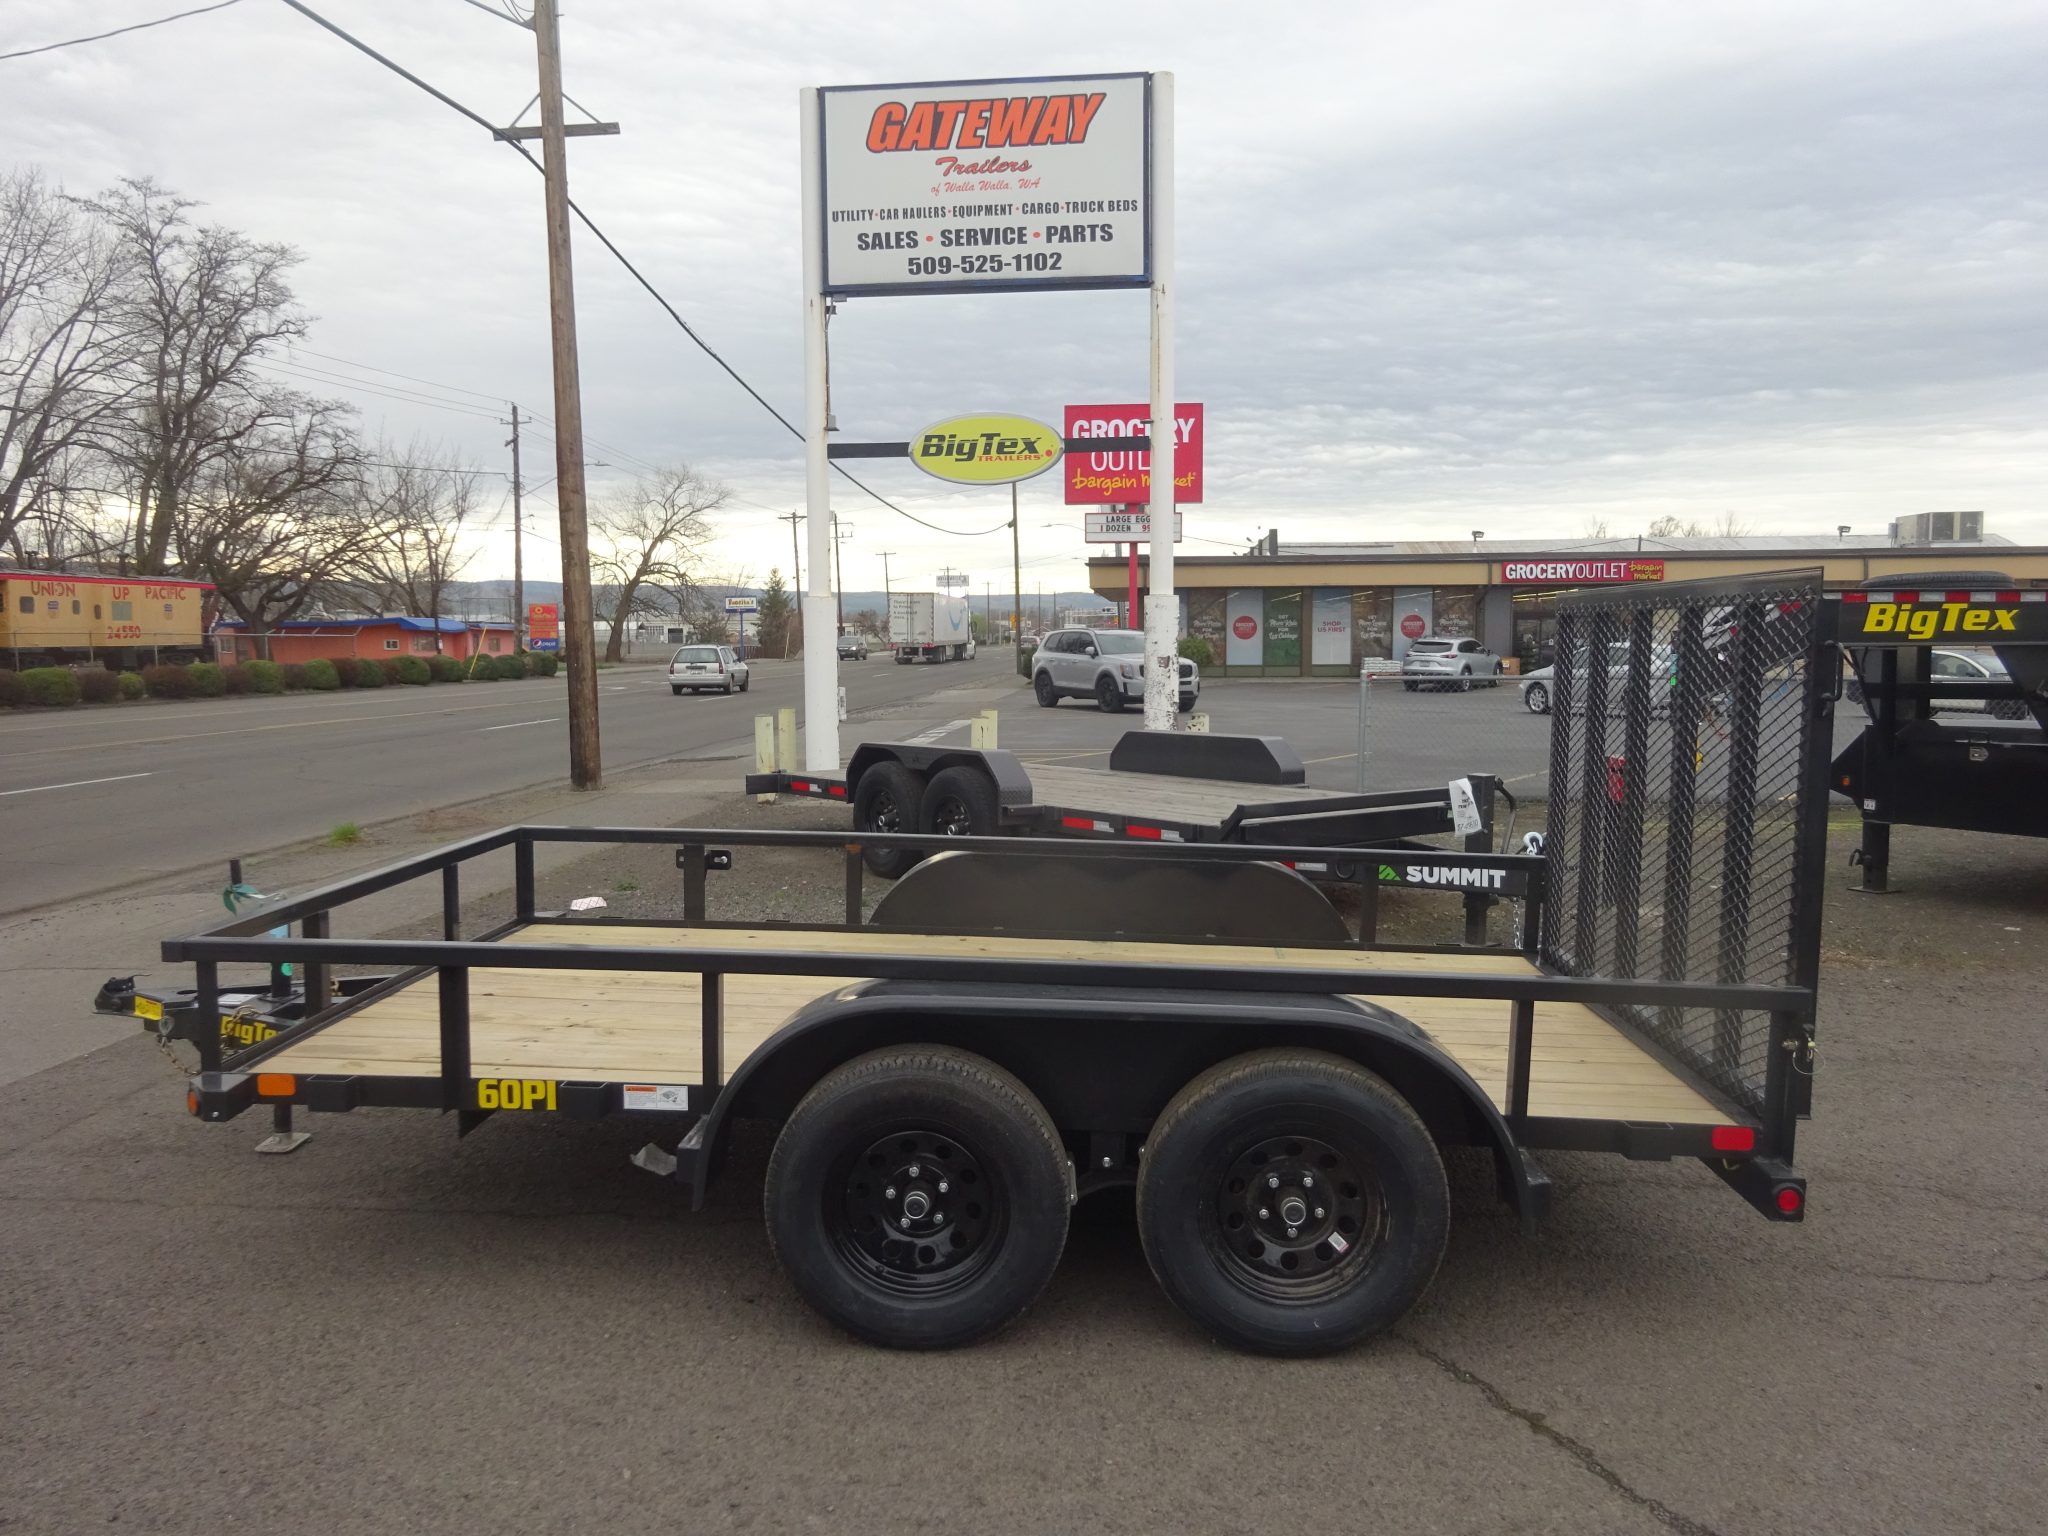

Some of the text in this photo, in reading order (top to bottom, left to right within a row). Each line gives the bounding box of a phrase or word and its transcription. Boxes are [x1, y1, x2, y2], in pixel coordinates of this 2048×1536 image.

[866, 92, 1107, 154] GATEWAY
[935, 156, 1033, 177] Trailers
[930, 183, 941, 196] of
[945, 181, 975, 192] Walla
[1018, 177, 1041, 189] WA
[832, 200, 1138, 222] UTILITY CAR HAULERS EQUIPMENT CARGO TRUCK BEDS
[857, 223, 1113, 250] SALES SERVICE PARTS
[907, 252, 1062, 276] 509-525-1102
[1072, 468, 1137, 496] bargain
[1106, 515, 1132, 523] LARGE
[1629, 561, 1663, 574] bargain
[1634, 572, 1662, 580] market
[31, 581, 186, 600] UNION UP PACIFIC
[1862, 603, 2019, 640] BigTex
[1406, 865, 1506, 888] SUMMIT
[478, 1078, 557, 1111] 60PI
